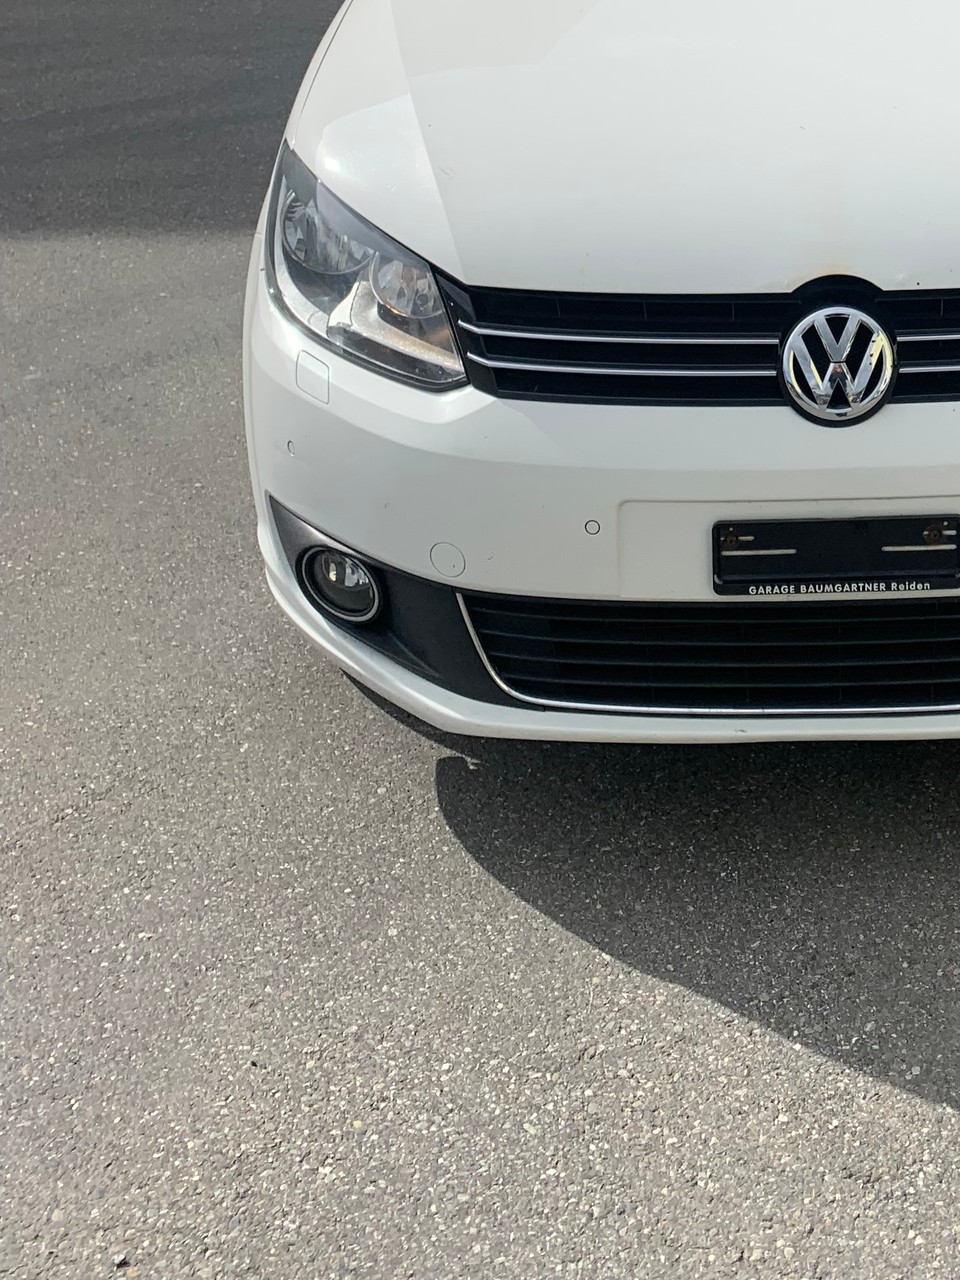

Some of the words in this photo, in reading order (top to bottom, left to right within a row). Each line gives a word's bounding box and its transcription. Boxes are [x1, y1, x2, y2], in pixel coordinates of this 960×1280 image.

[749, 585, 796, 596] GARAGE
[800, 583, 886, 594] BAUMGARTNER
[891, 581, 931, 591] Reiden
